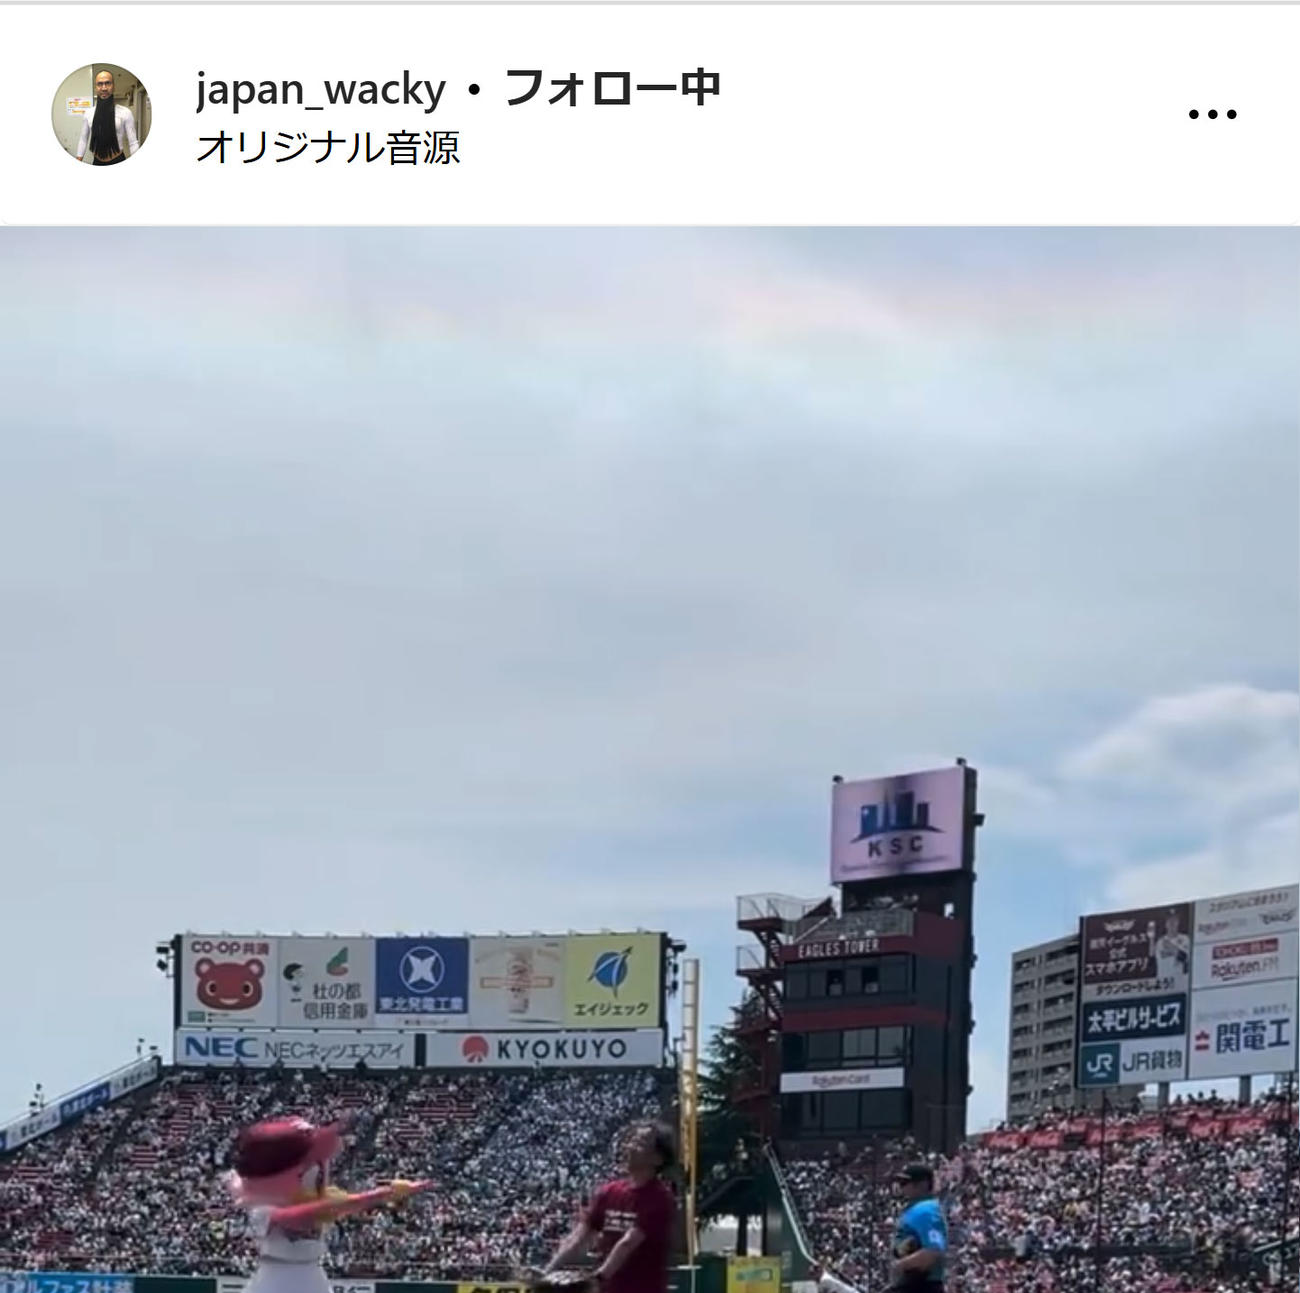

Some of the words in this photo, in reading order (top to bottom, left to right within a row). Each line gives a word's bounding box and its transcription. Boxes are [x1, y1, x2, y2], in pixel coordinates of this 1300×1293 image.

[868, 836, 923, 857] KSC
[798, 943, 840, 959] EAGLES
[845, 938, 880, 955] TOWER
[313, 983, 361, 1000] 杜の都
[303, 1002, 368, 1020] 信用金庫
[575, 1003, 649, 1017] エイジェック
[1087, 1002, 1181, 1034] 太平ビルサービス
[1216, 1018, 1290, 1055] 関電工
[185, 1037, 259, 1058] NEC
[498, 1038, 627, 1059] KYOKUYO
[1086, 1053, 1112, 1073] JR
[1122, 1049, 1183, 1073] JR貨物
